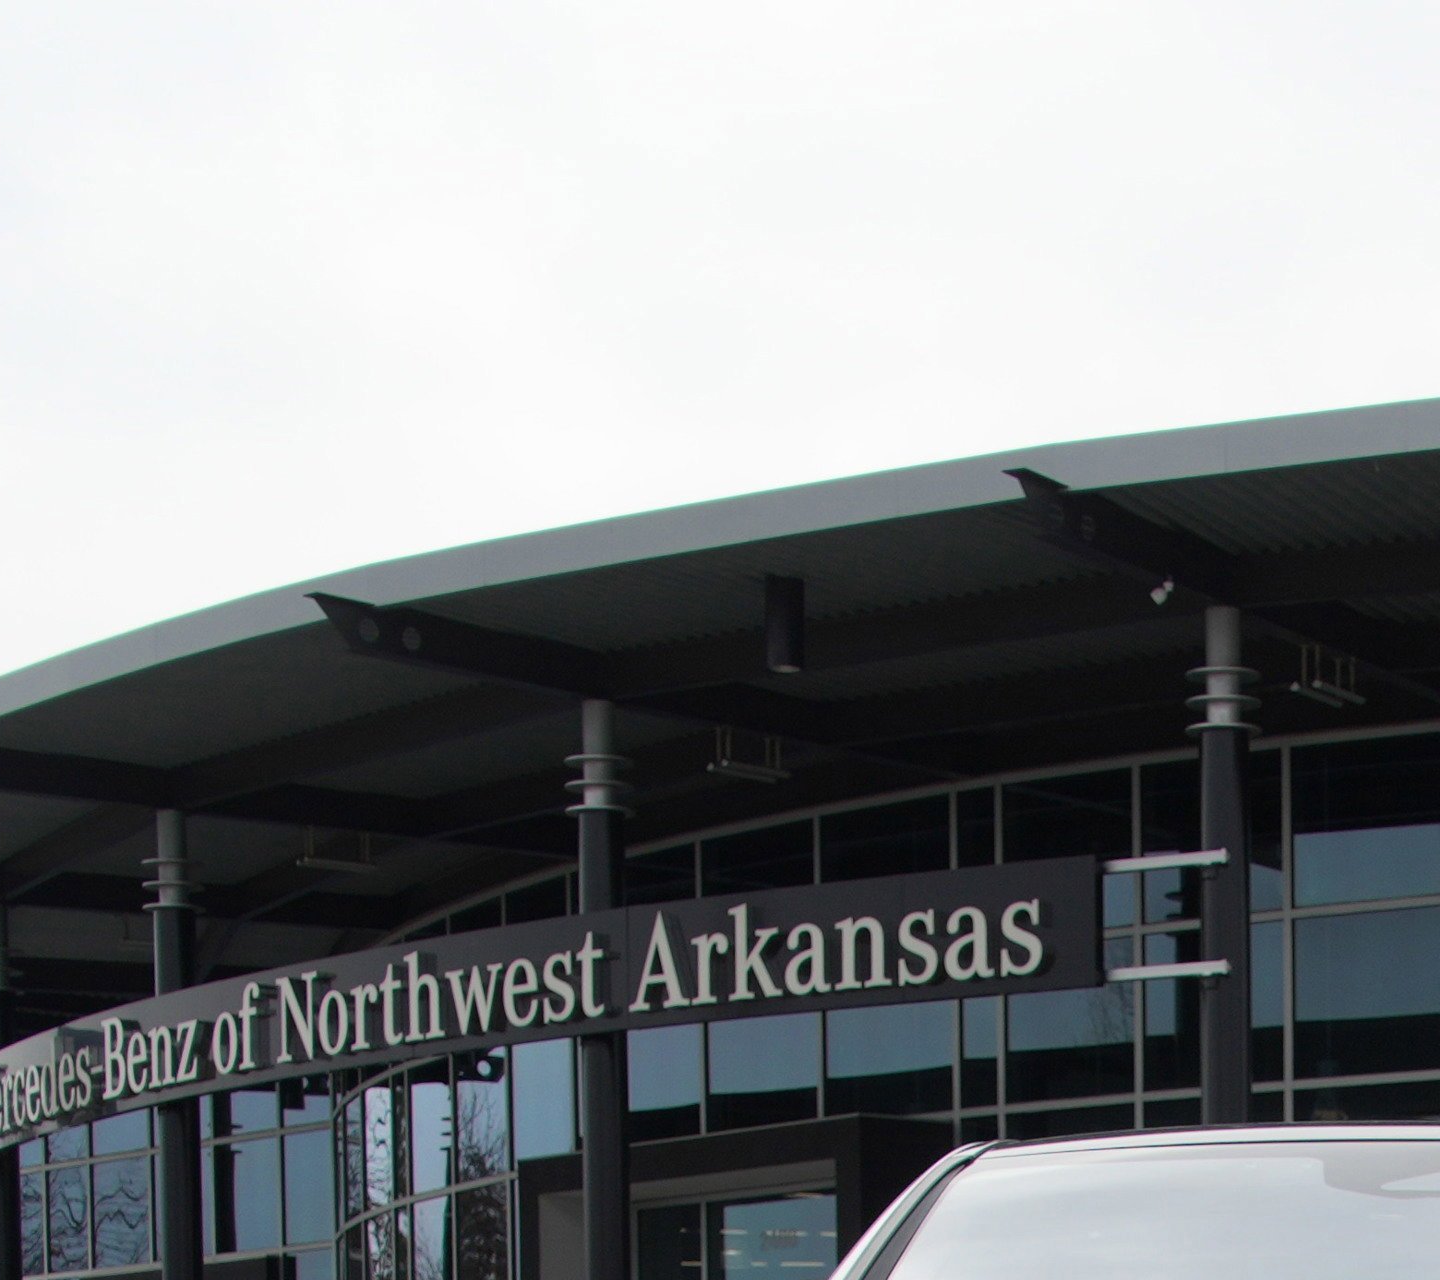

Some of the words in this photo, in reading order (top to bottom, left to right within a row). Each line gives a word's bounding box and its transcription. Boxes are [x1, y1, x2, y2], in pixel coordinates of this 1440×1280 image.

[211, 981, 260, 1075] of
[275, 930, 605, 1064] Northwest
[628, 897, 1045, 1013] Arkansas
